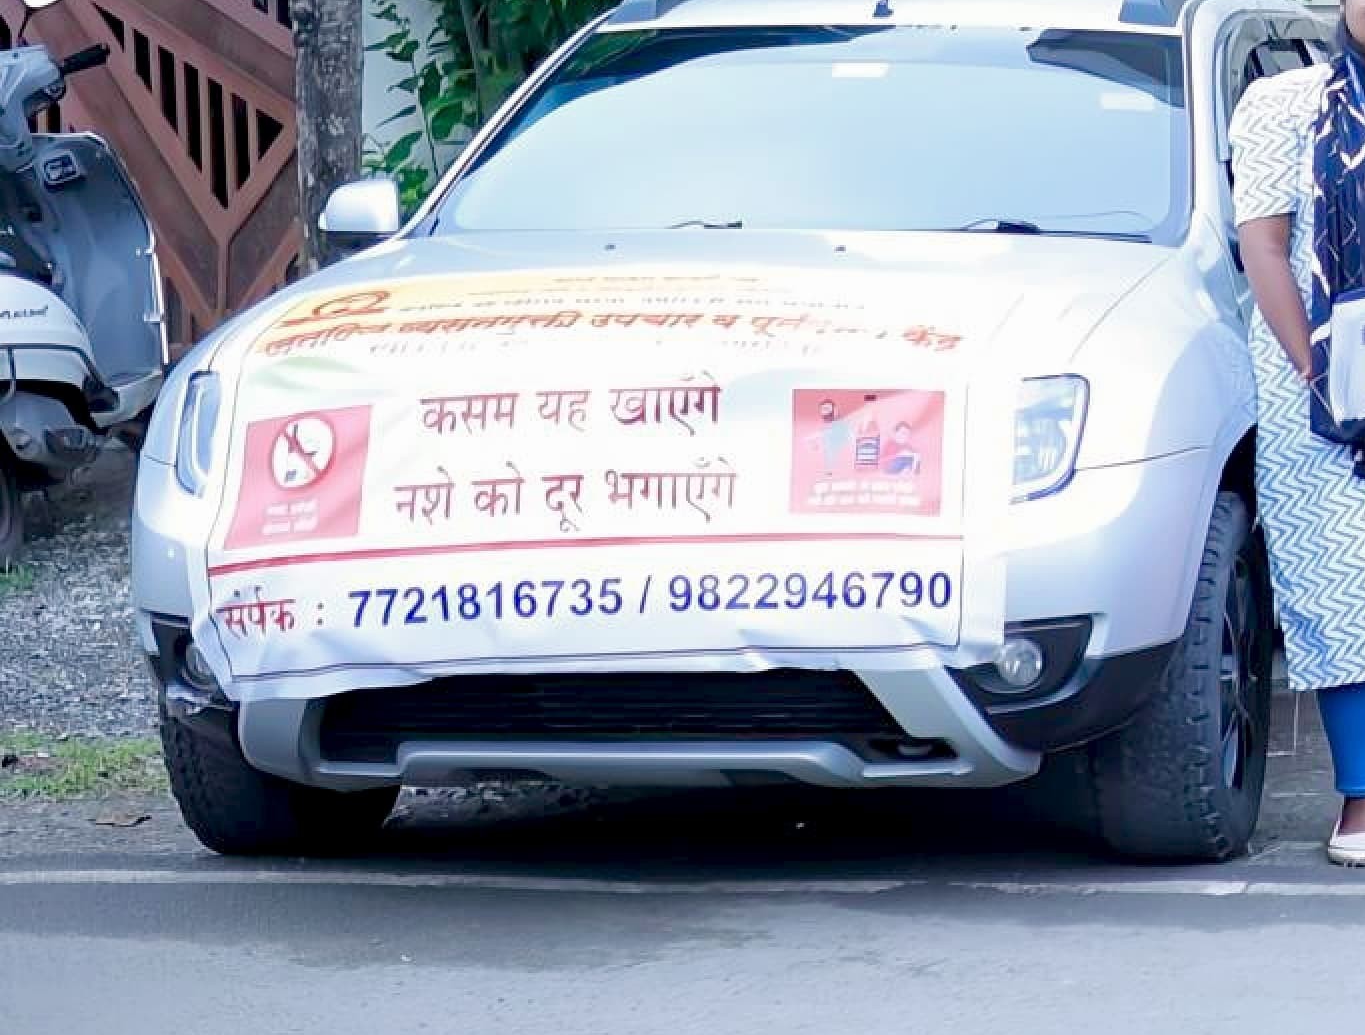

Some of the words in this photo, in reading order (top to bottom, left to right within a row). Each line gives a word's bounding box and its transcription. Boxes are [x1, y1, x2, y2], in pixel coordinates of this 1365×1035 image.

[418, 391, 522, 435] कसम
[534, 389, 594, 433] यह
[392, 465, 456, 527] नशे
[471, 460, 526, 518] को
[541, 473, 586, 533] दूर
[346, 577, 626, 629] 7721816735
[638, 573, 653, 615] /
[667, 570, 952, 613] 9822946790
